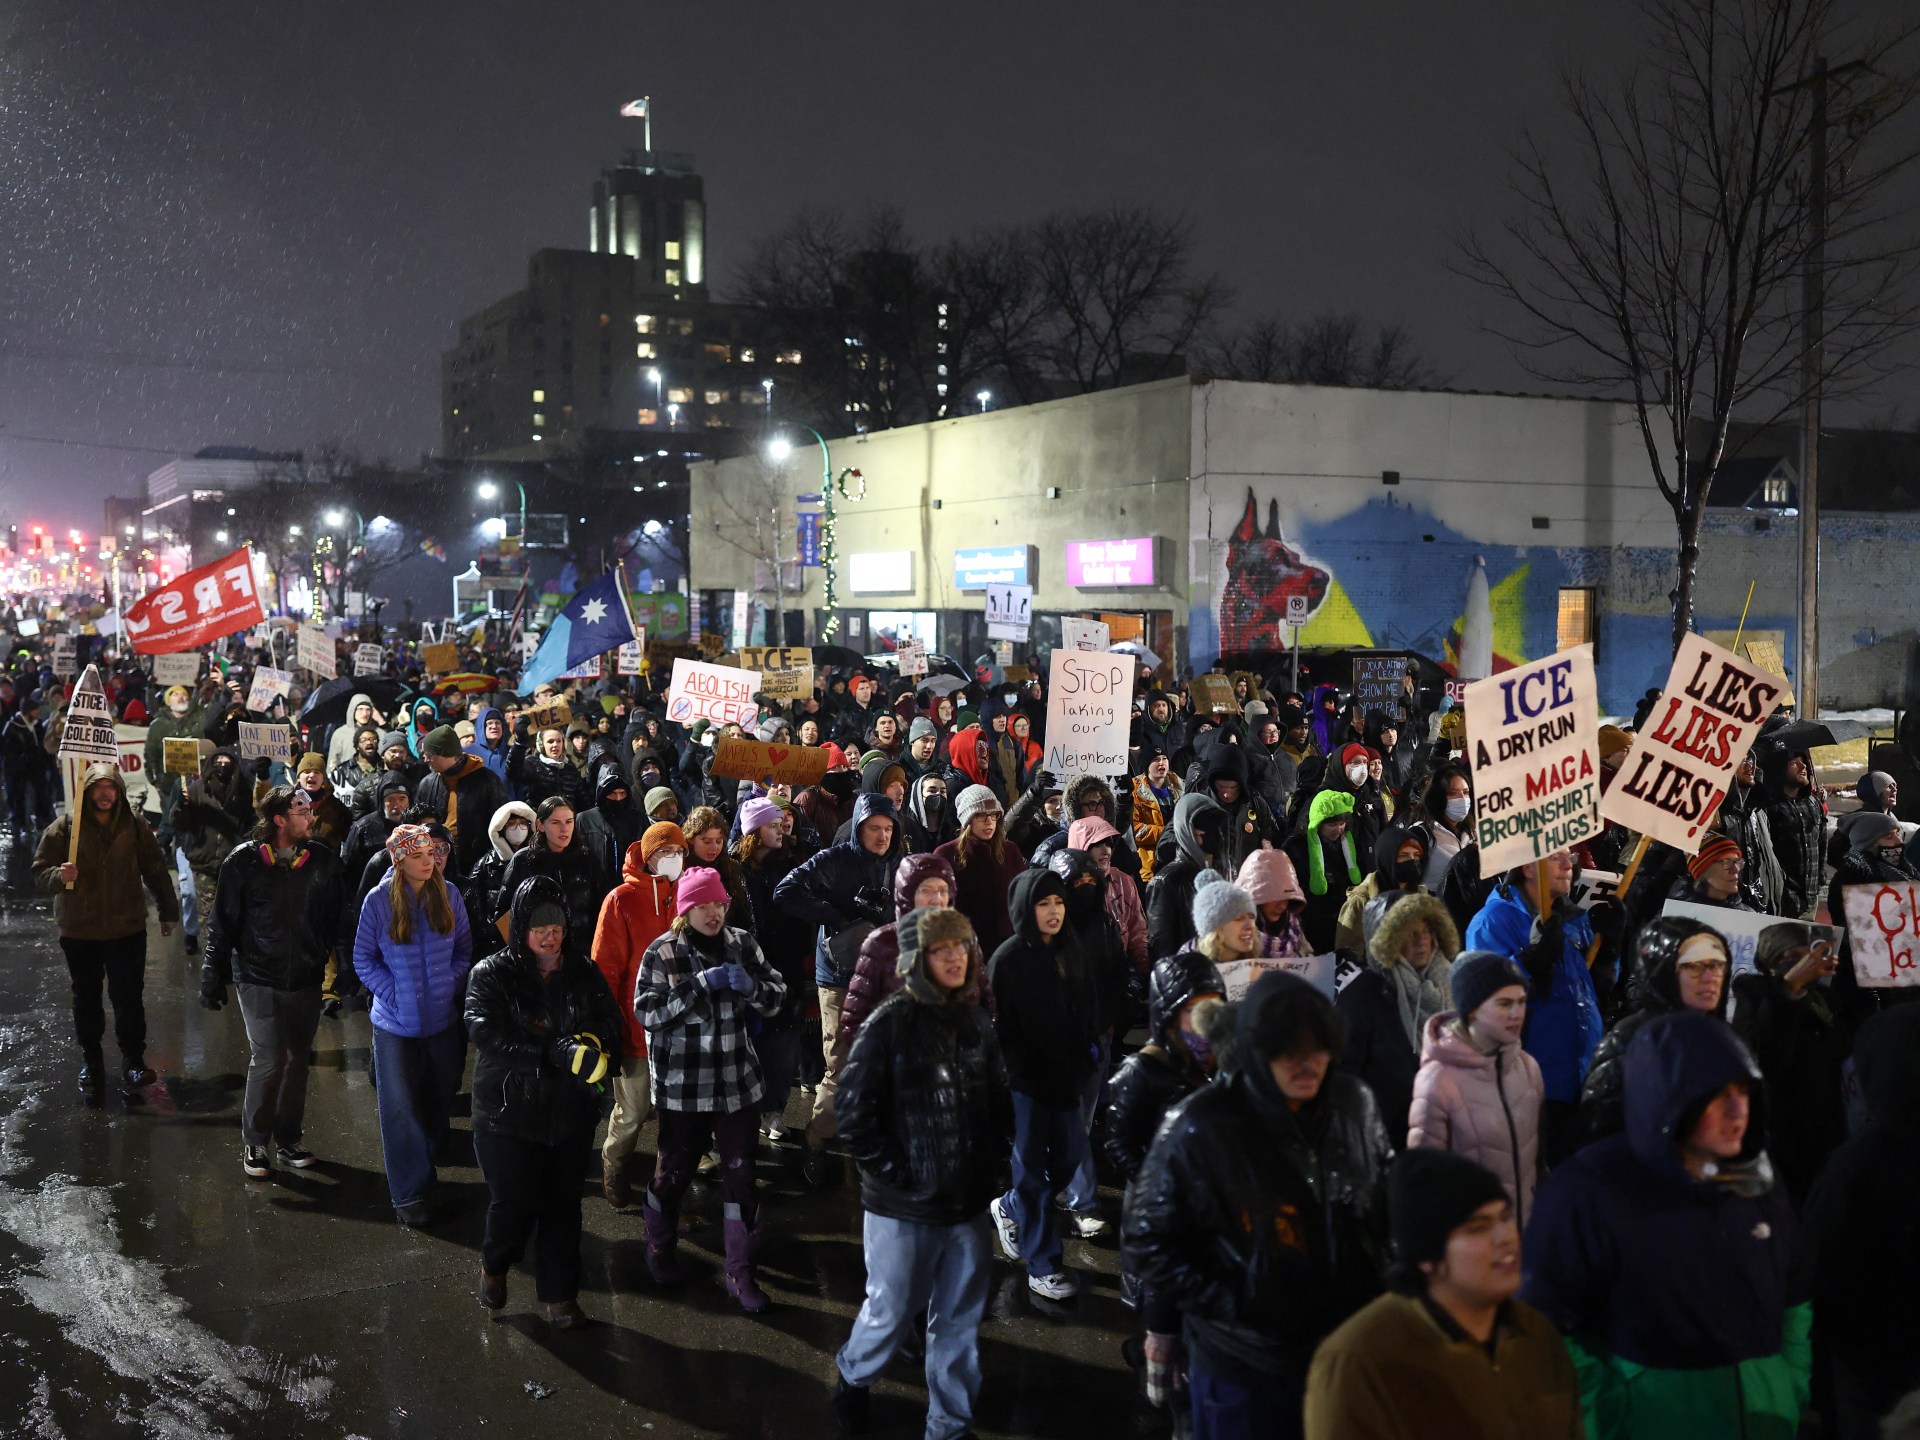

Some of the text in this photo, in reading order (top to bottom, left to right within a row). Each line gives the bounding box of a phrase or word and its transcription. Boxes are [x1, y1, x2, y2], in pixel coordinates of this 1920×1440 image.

[1061, 659, 1123, 695] STOP
[1356, 660, 1362, 670] IF
[1366, 660, 1385, 671] YOUR
[1361, 672, 1373, 680] ARE
[685, 672, 750, 703] ABOLISH
[1358, 682, 1398, 698] SHOW ME
[1685, 651, 1779, 725] LIES,
[1059, 698, 1114, 725] Taking
[240, 725, 289, 743] LOVE THY
[1072, 723, 1100, 733] our
[1476, 712, 1575, 770] A DRY RUN
[1651, 697, 1743, 771] LIES,
[243, 742, 290, 757] NEIGHBOR
[720, 743, 758, 762] MPLS
[1049, 744, 1125, 772] Neighbors
[1477, 748, 1594, 819] FOR MAGA
[1621, 751, 1725, 838] LIES!
[1478, 782, 1594, 849] BROWNSHIRT
[1527, 801, 1598, 858] THUGS!
